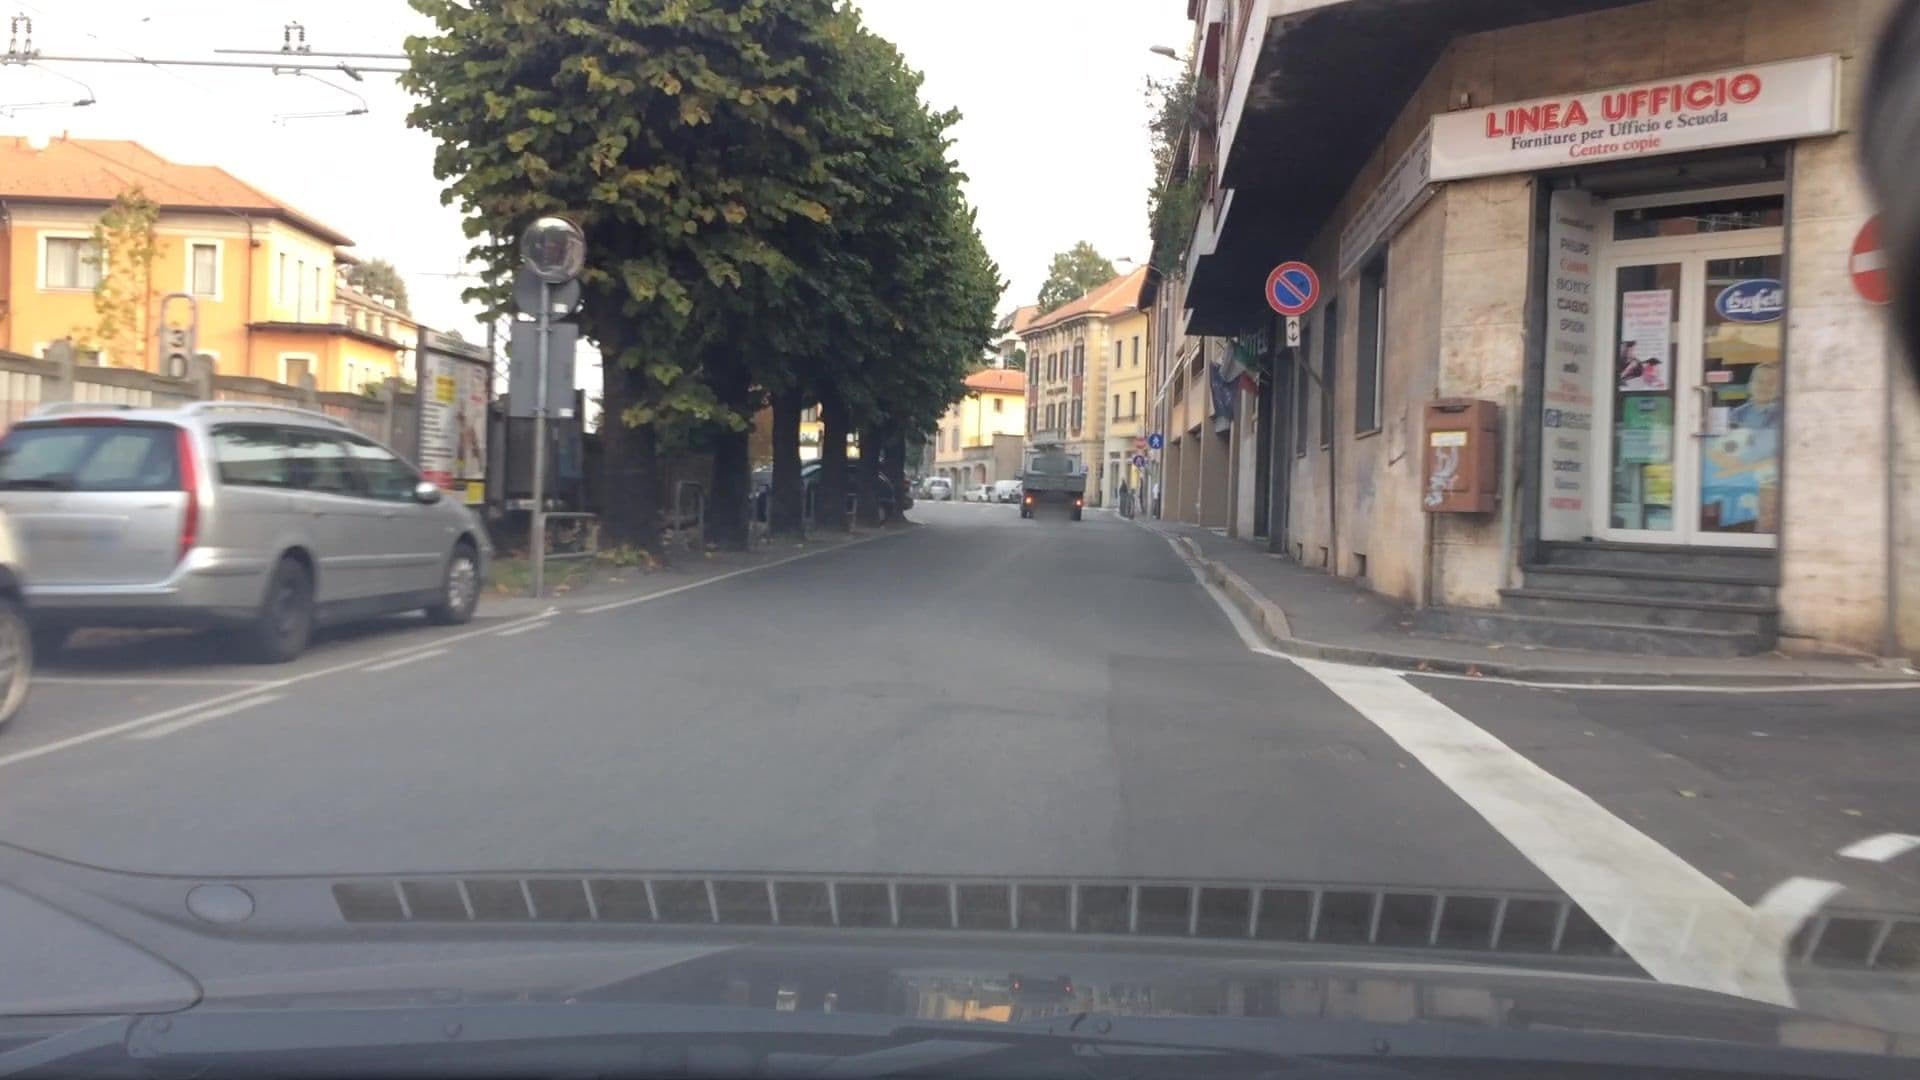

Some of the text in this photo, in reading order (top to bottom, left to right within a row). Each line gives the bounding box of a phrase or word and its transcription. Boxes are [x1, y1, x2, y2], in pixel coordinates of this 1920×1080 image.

[1485, 73, 1762, 138] LINEA UFFICIO
[1511, 109, 1728, 150] Forniture per Ufficio e Scuola
[1569, 135, 1661, 158] Centro copie
